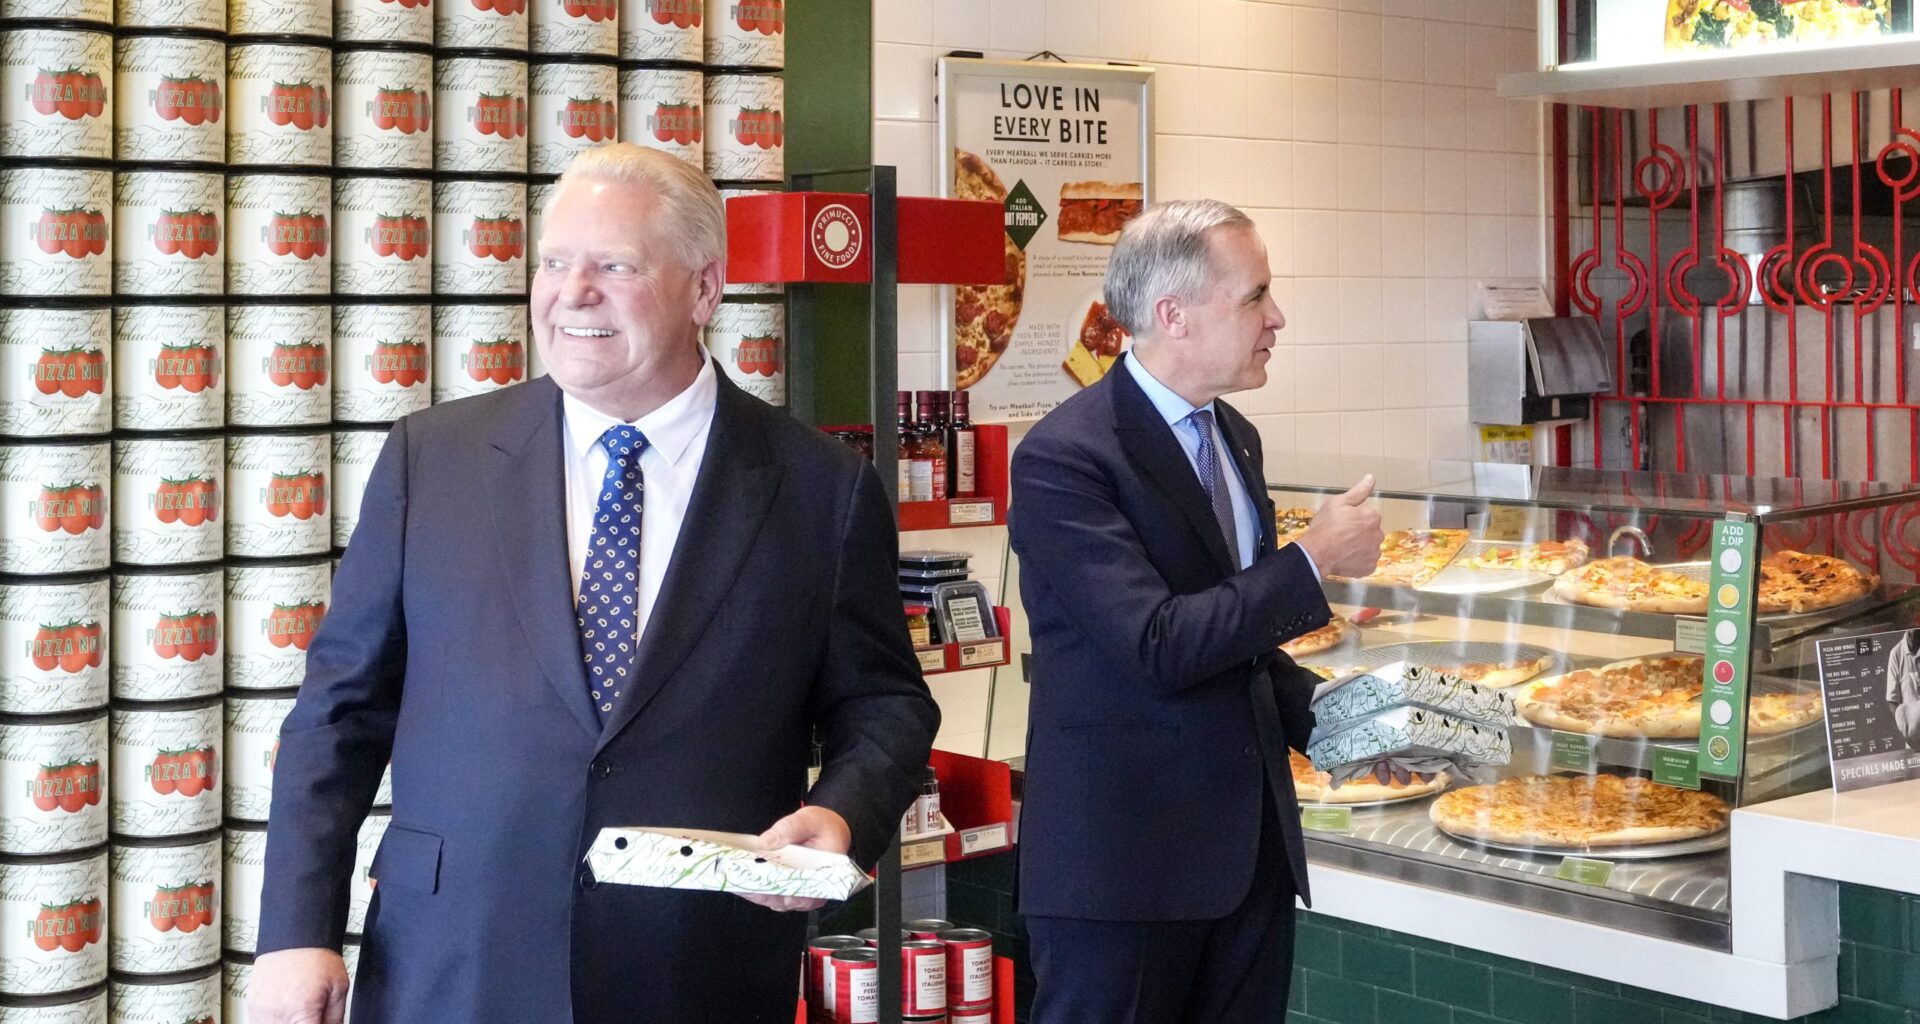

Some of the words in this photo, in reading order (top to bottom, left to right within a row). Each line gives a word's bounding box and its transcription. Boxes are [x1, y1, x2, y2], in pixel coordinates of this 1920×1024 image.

[25, 83, 73, 101] PIZZA
[149, 90, 195, 108] PIZZA
[1001, 83, 1063, 110] LOVE
[1076, 88, 1099, 112] IN
[261, 95, 305, 113] PIZZA
[366, 100, 408, 118] PIZZA
[467, 106, 507, 122] PIZZA
[556, 110, 596, 127] PIZZA
[729, 118, 767, 135] PIZZA
[994, 116, 1051, 136] EVERY
[1060, 119, 1107, 144] BITE
[818, 210, 854, 230] PRIMUCCI
[1016, 212, 1038, 226] PEPPERS
[30, 222, 78, 241] PIZZA
[148, 224, 195, 242] PIZZA
[261, 225, 305, 243] PIZZA
[365, 227, 408, 244] PIZZA
[462, 229, 503, 246] PIZZA
[818, 244, 834, 262] FINE
[836, 241, 857, 263] FOODS
[365, 355, 407, 372] PIZZA
[461, 353, 502, 370] PIZZA
[732, 347, 767, 363] PIZZA
[28, 361, 75, 381] PIZZA
[149, 358, 195, 376] PIZZA
[262, 357, 306, 374] PIZZA
[148, 492, 195, 511] PIZZA
[260, 486, 304, 504] PIZZA
[28, 498, 75, 519] PIZZA
[1722, 526, 1743, 535] ADD
[1728, 537, 1743, 545] DIP
[261, 617, 307, 636] PIZZA
[147, 629, 193, 647] PIZZA
[25, 638, 77, 659] PIZZA
[144, 763, 191, 783] PIZZA
[1841, 764, 1879, 780] SPECIALS
[1882, 760, 1905, 772] MADE
[26, 777, 74, 799] PIZZA
[144, 900, 190, 920] PIZZA
[27, 917, 75, 938] PIZZA
